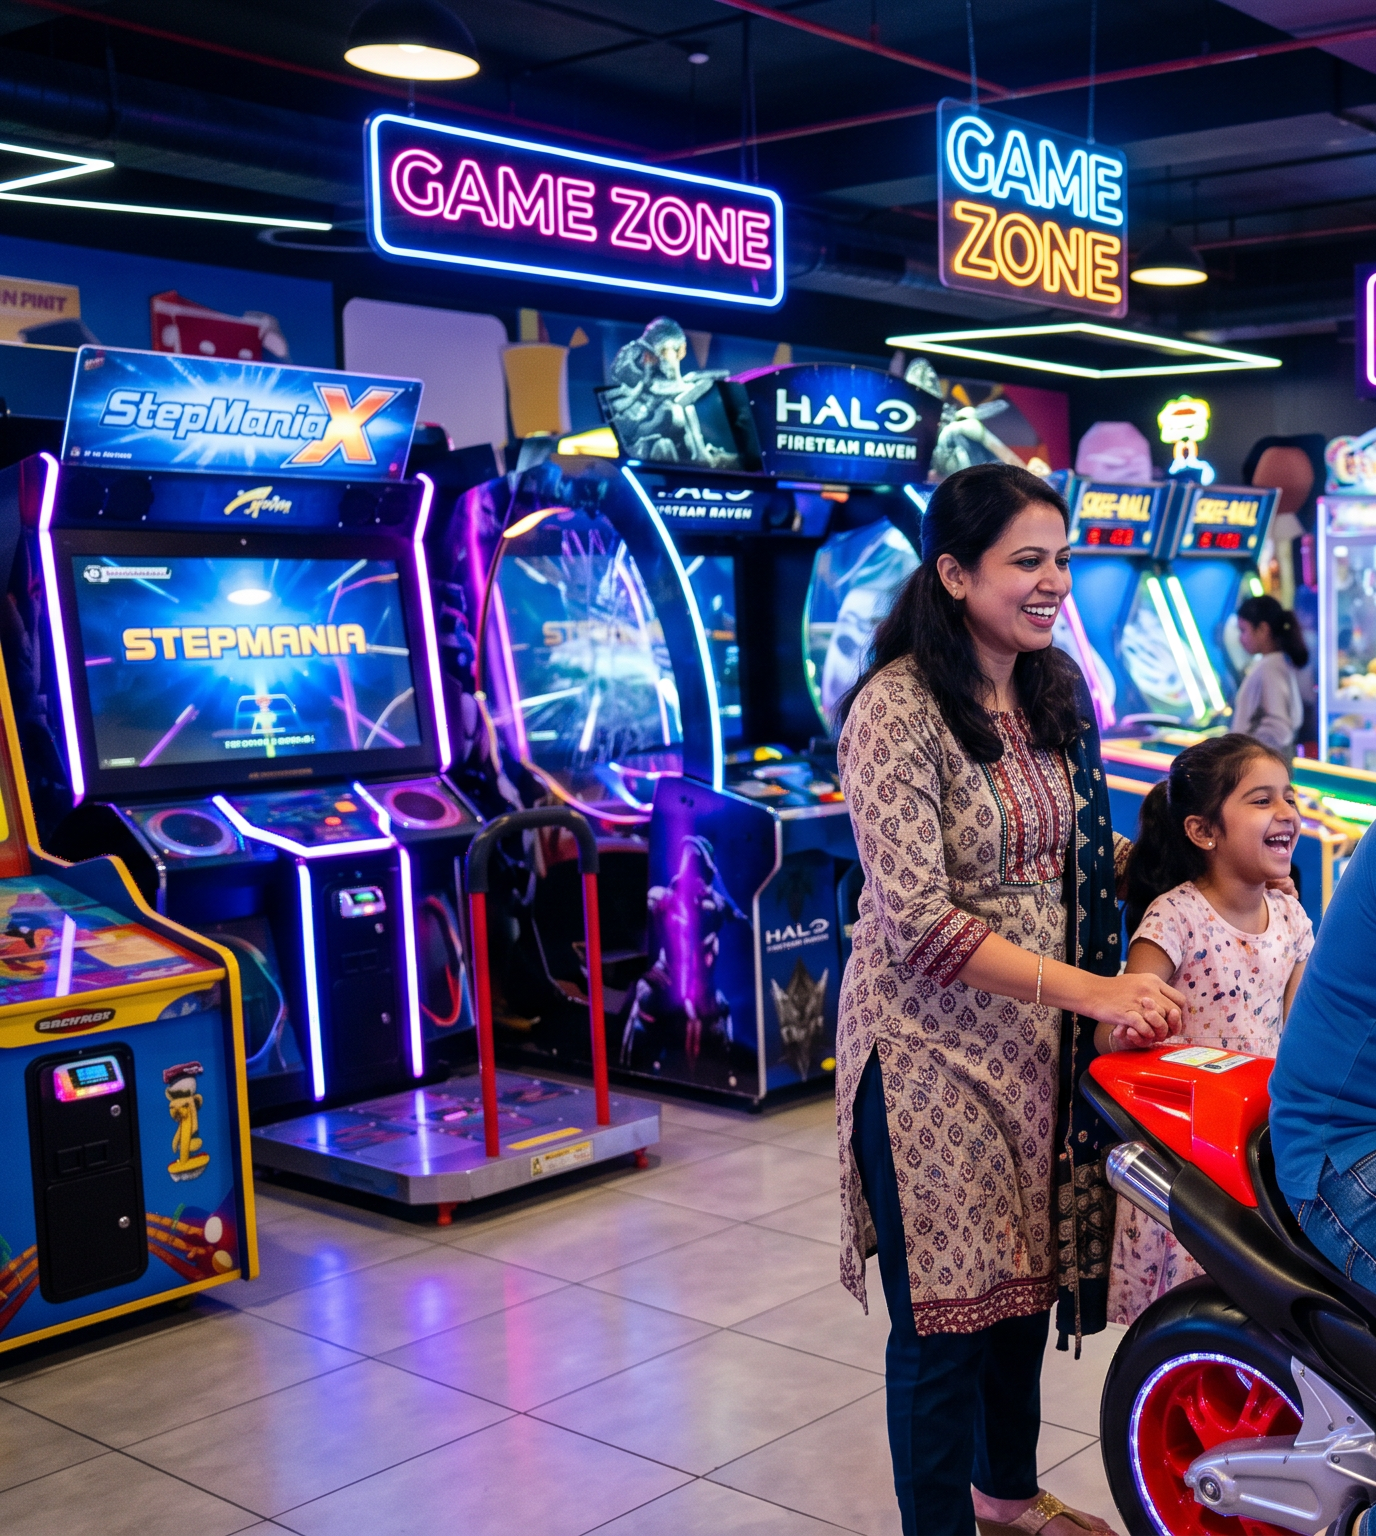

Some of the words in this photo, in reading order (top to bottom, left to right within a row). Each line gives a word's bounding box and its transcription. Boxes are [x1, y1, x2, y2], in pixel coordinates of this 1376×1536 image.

[946, 115, 1123, 227] GAME
[390, 148, 598, 243] GAME
[610, 186, 772, 271] ZONE
[954, 200, 1122, 304] ZONE
[775, 388, 918, 433] HALO
[776, 433, 860, 456] FIRETEAM
[864, 440, 917, 461] RAVEN
[122, 622, 368, 662] STEPMANIA
[765, 918, 830, 945] HALO
